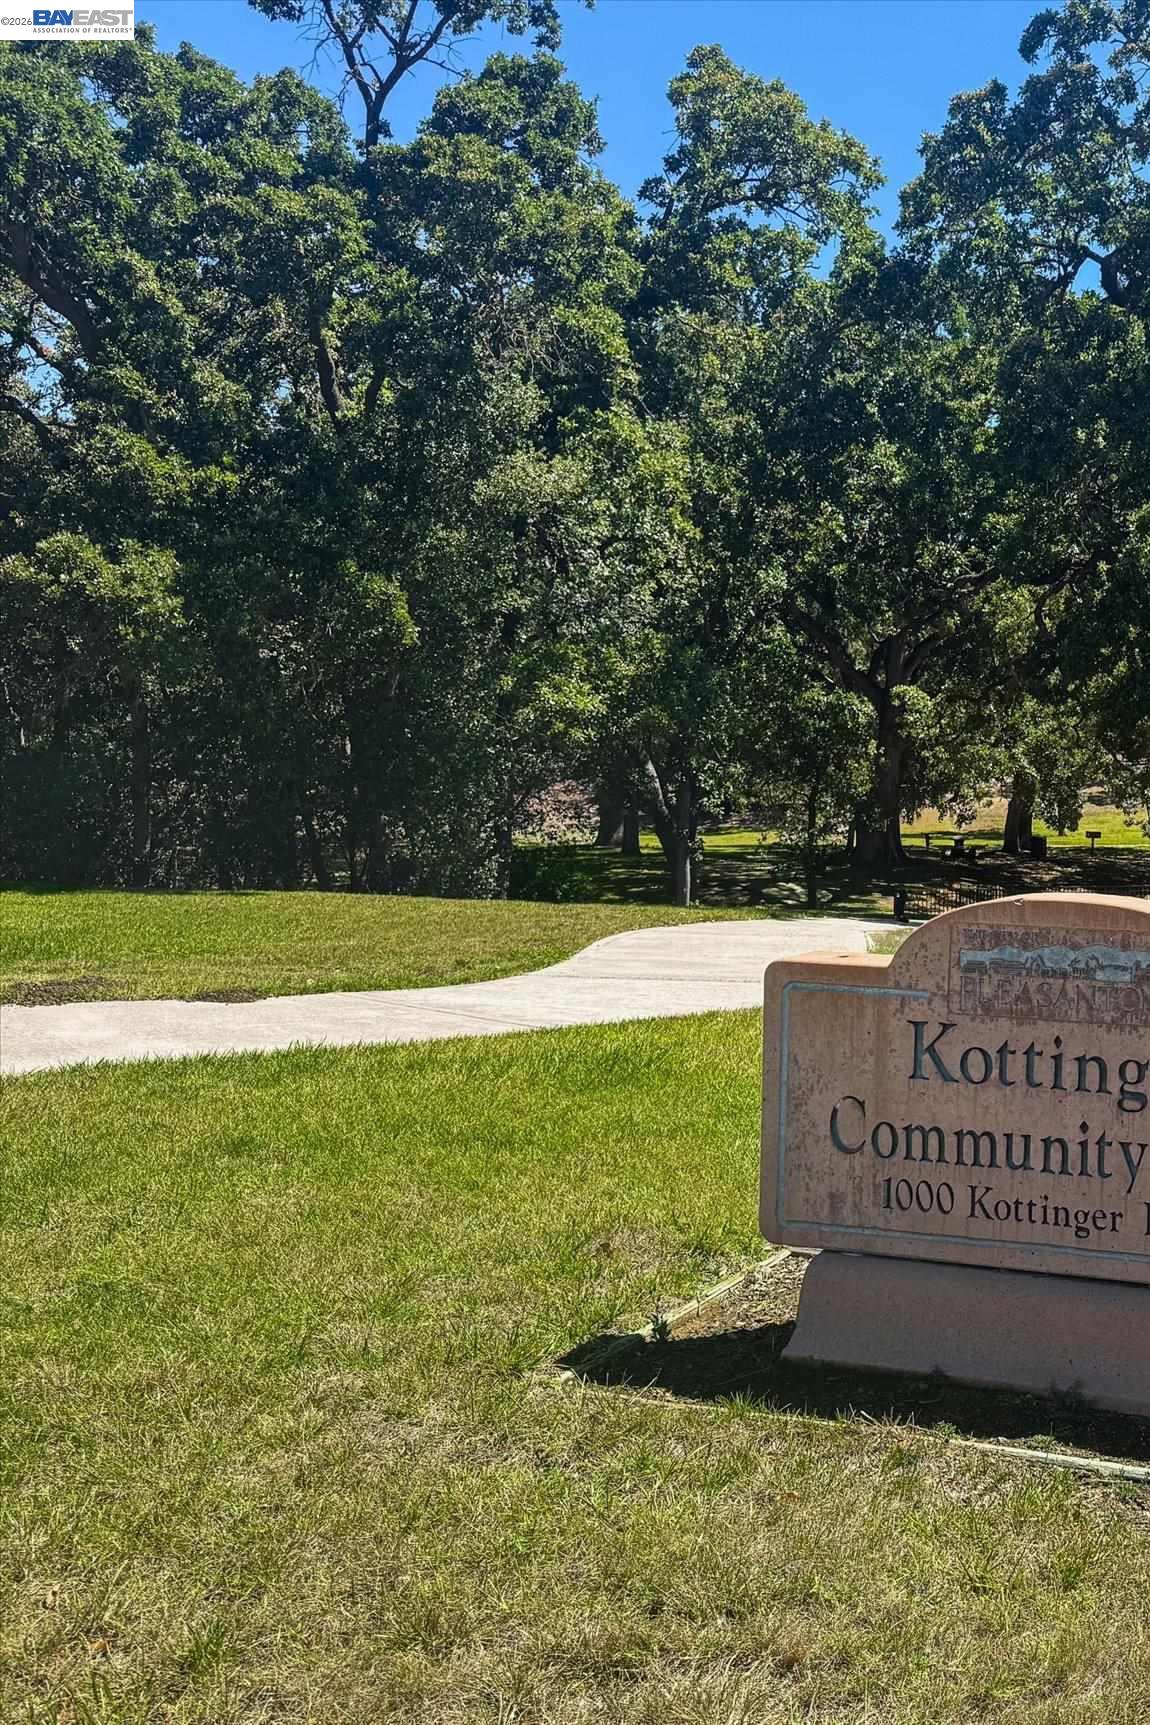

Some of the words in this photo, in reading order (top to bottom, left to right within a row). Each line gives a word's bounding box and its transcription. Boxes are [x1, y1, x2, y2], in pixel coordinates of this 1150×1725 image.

[829, 1095, 1149, 1194] Community
[881, 1176, 955, 1215] 1000
[966, 1184, 1124, 1239] Kottinger
